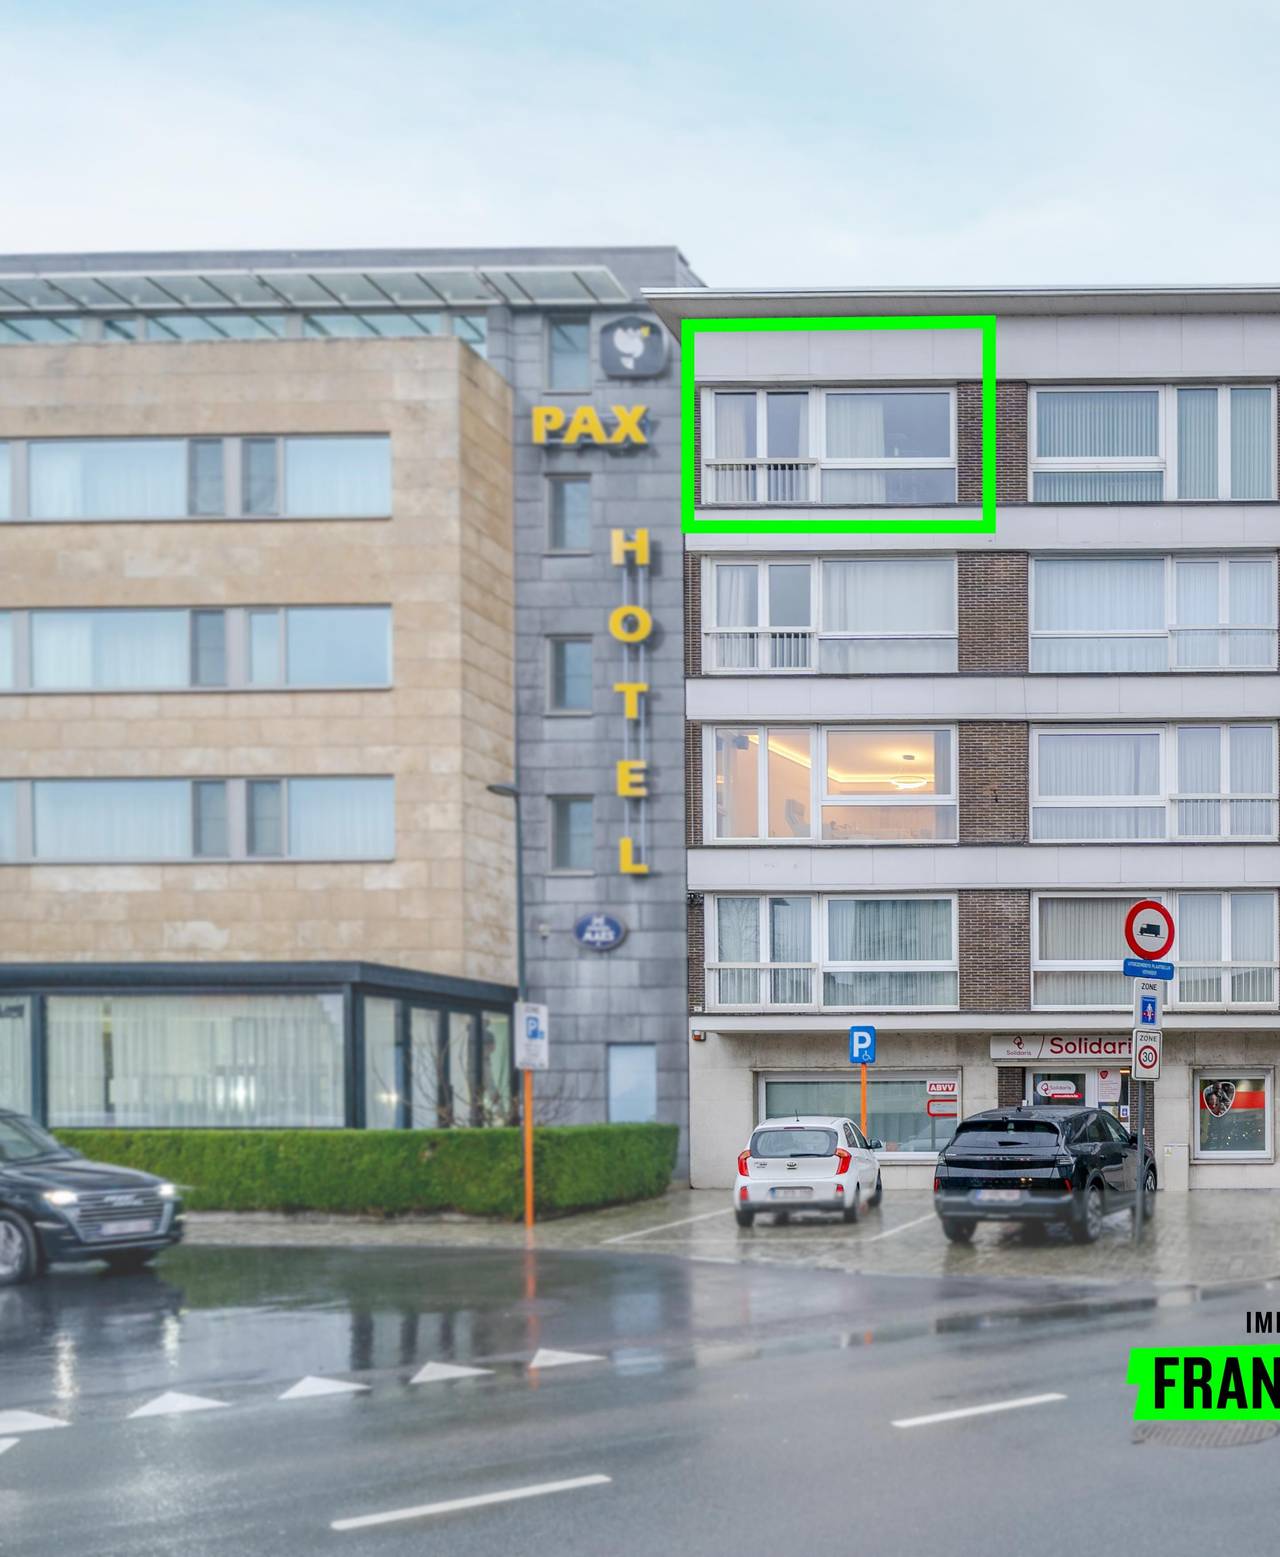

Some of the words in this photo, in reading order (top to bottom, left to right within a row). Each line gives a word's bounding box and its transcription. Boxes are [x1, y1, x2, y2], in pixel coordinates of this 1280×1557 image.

[531, 405, 648, 444] PAX
[608, 528, 653, 874] HOTEL
[1141, 983, 1158, 991] ZONE
[852, 1031, 871, 1058] P
[1049, 1037, 1133, 1055] Solidari
[1142, 1051, 1154, 1063] 30
